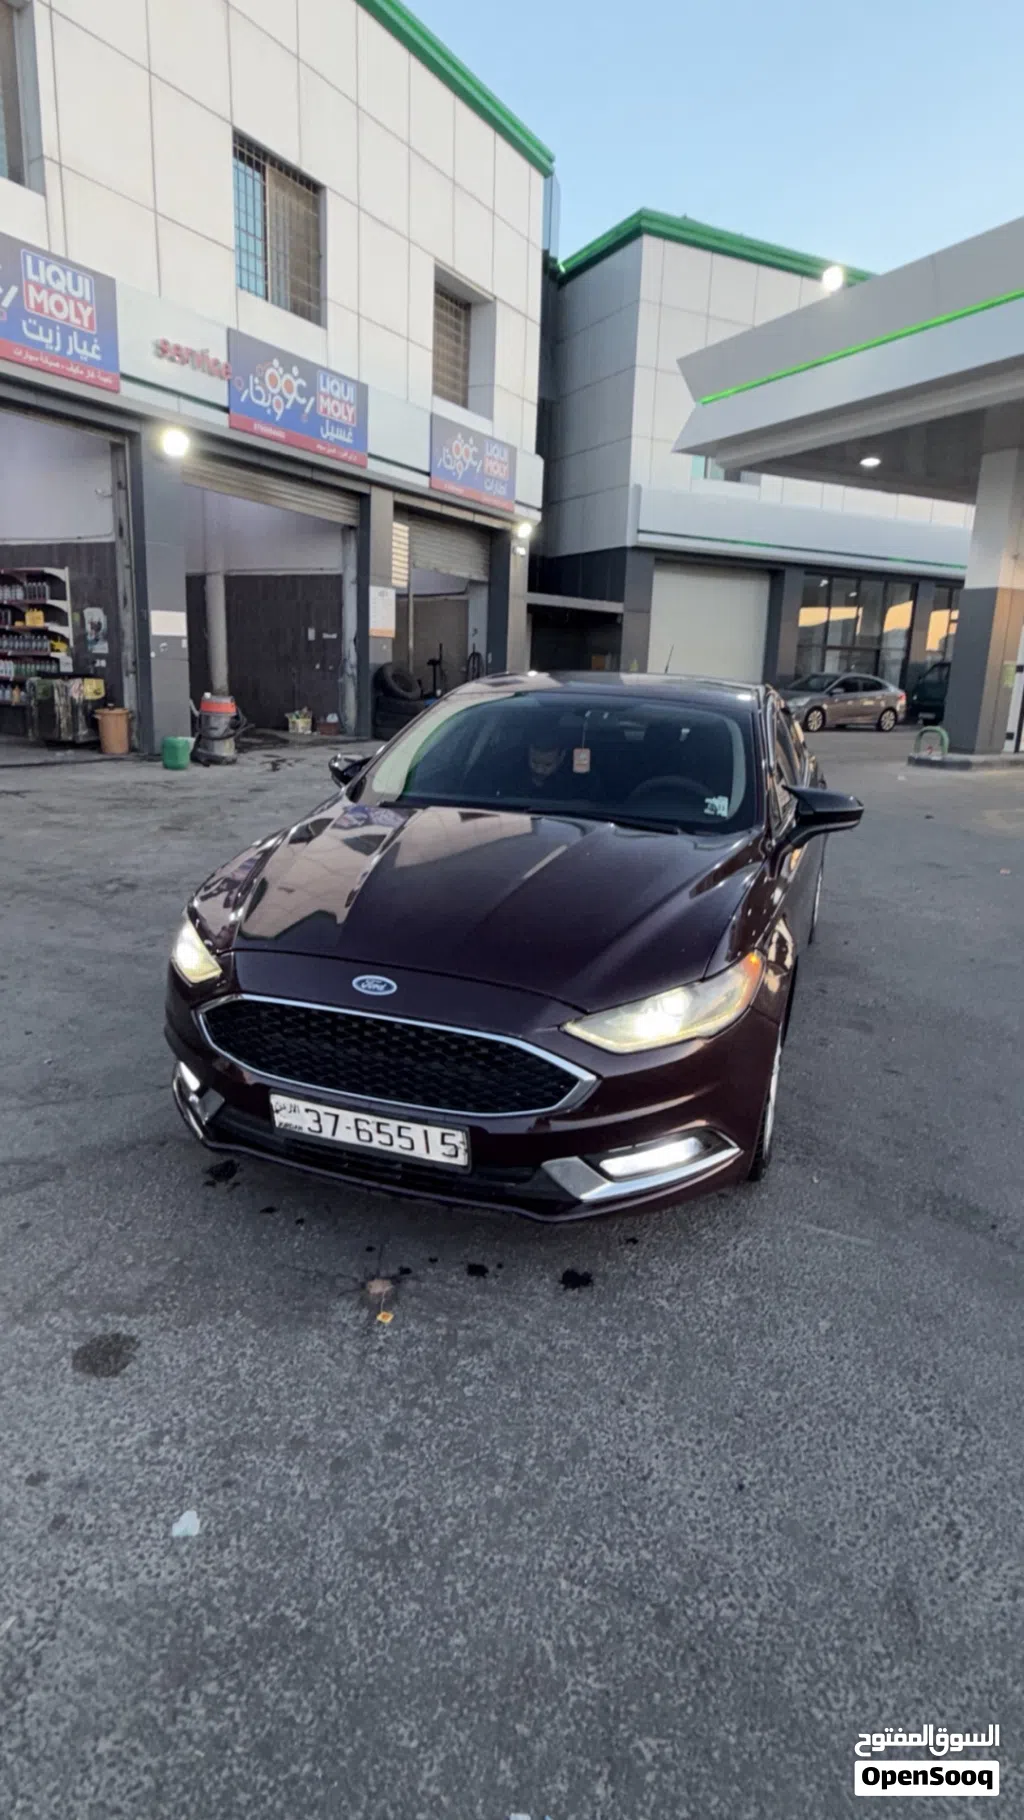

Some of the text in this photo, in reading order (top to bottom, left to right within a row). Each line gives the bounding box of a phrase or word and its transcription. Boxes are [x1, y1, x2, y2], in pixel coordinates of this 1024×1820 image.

[25, 255, 91, 301] LIQUI
[27, 283, 94, 328] MOLY
[22, 317, 102, 361] غيار زيت
[319, 372, 354, 404] LIQUI
[319, 393, 356, 422] MOLY
[304, 1108, 460, 1158] 37-65515
